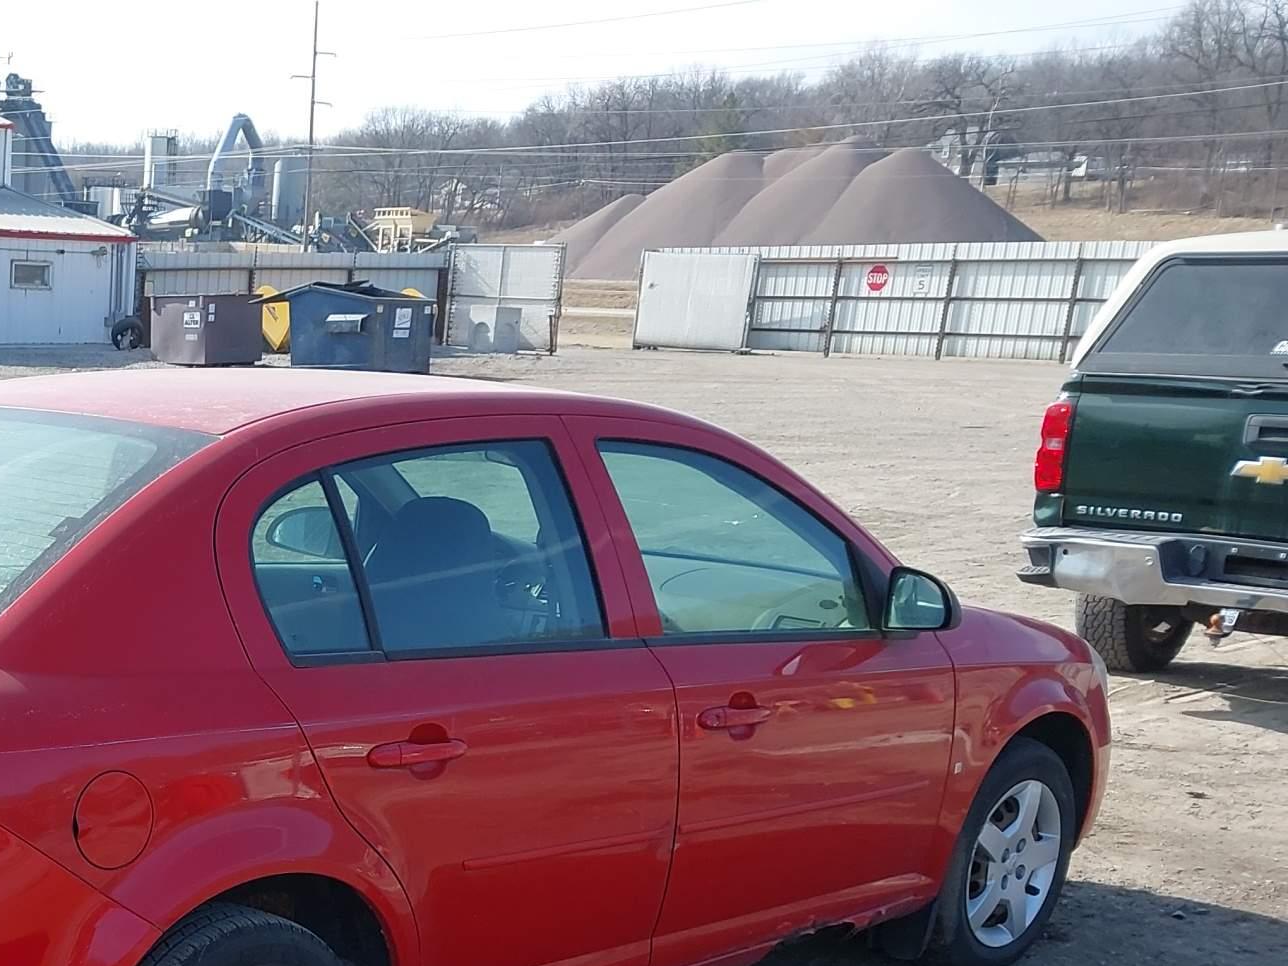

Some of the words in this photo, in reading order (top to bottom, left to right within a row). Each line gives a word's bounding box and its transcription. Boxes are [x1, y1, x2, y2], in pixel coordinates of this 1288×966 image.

[867, 272, 889, 284] STOP
[918, 280, 925, 290] 5
[1075, 504, 1184, 523] SILVERADO
